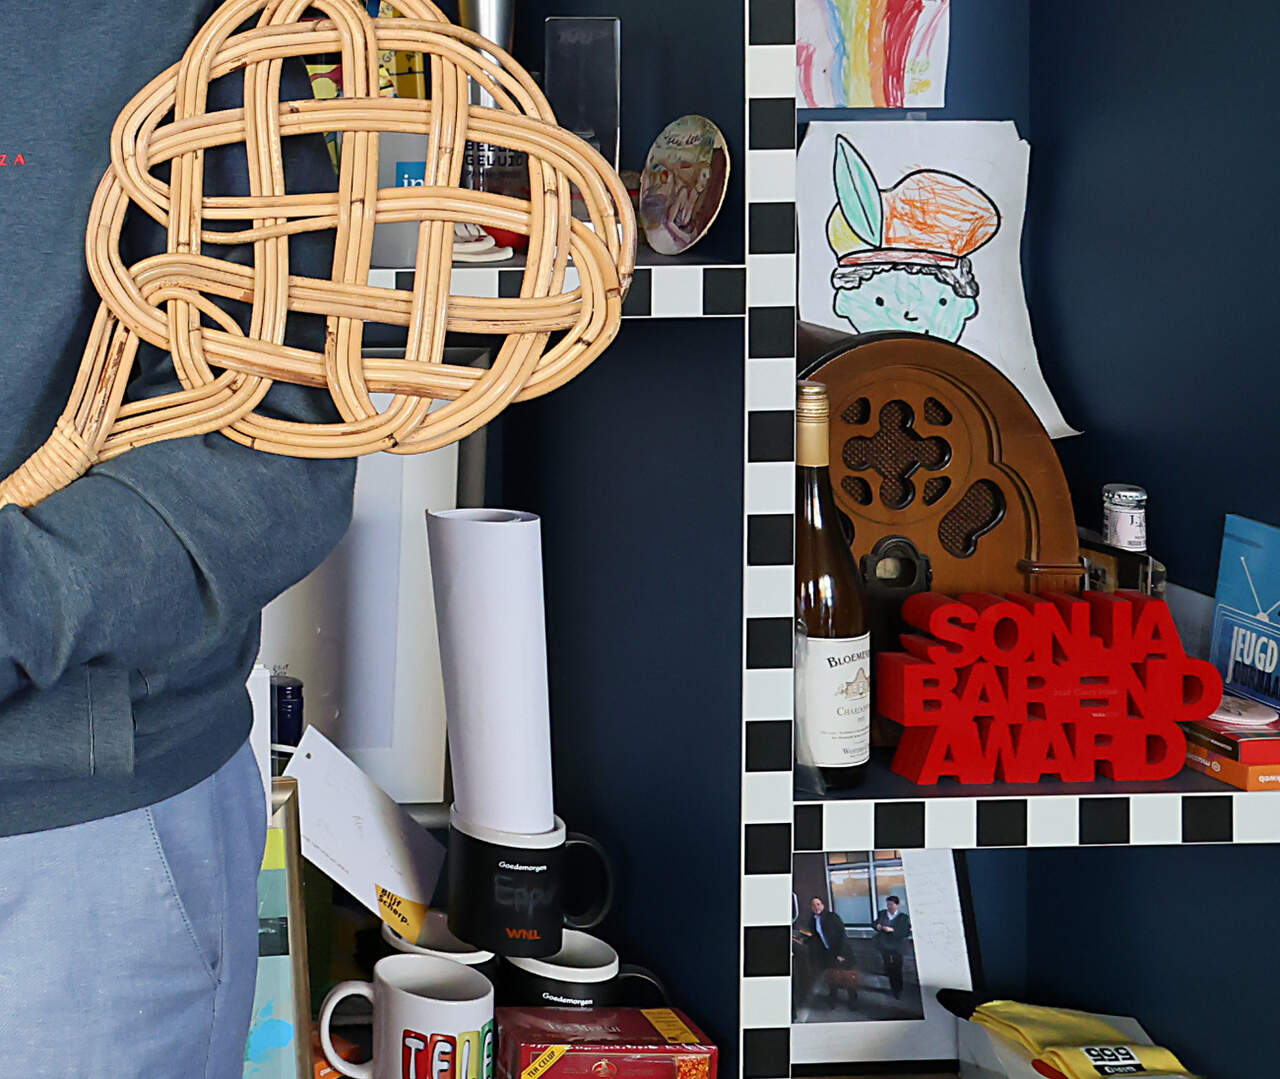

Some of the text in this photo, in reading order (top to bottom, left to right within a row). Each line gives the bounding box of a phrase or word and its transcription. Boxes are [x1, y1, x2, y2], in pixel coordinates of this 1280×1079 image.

[922, 596, 1186, 668] SONJA
[1225, 626, 1279, 684] JEUGD
[900, 655, 1224, 727] BAREND
[914, 722, 1188, 785] AWARD
[498, 861, 547, 872] Goedemorgen
[377, 894, 410, 926] Scherp.
[380, 887, 402, 908] Blijf
[505, 927, 541, 940] WNL
[542, 991, 594, 1007] Goedemorgen
[1084, 1046, 1136, 1063] 555
